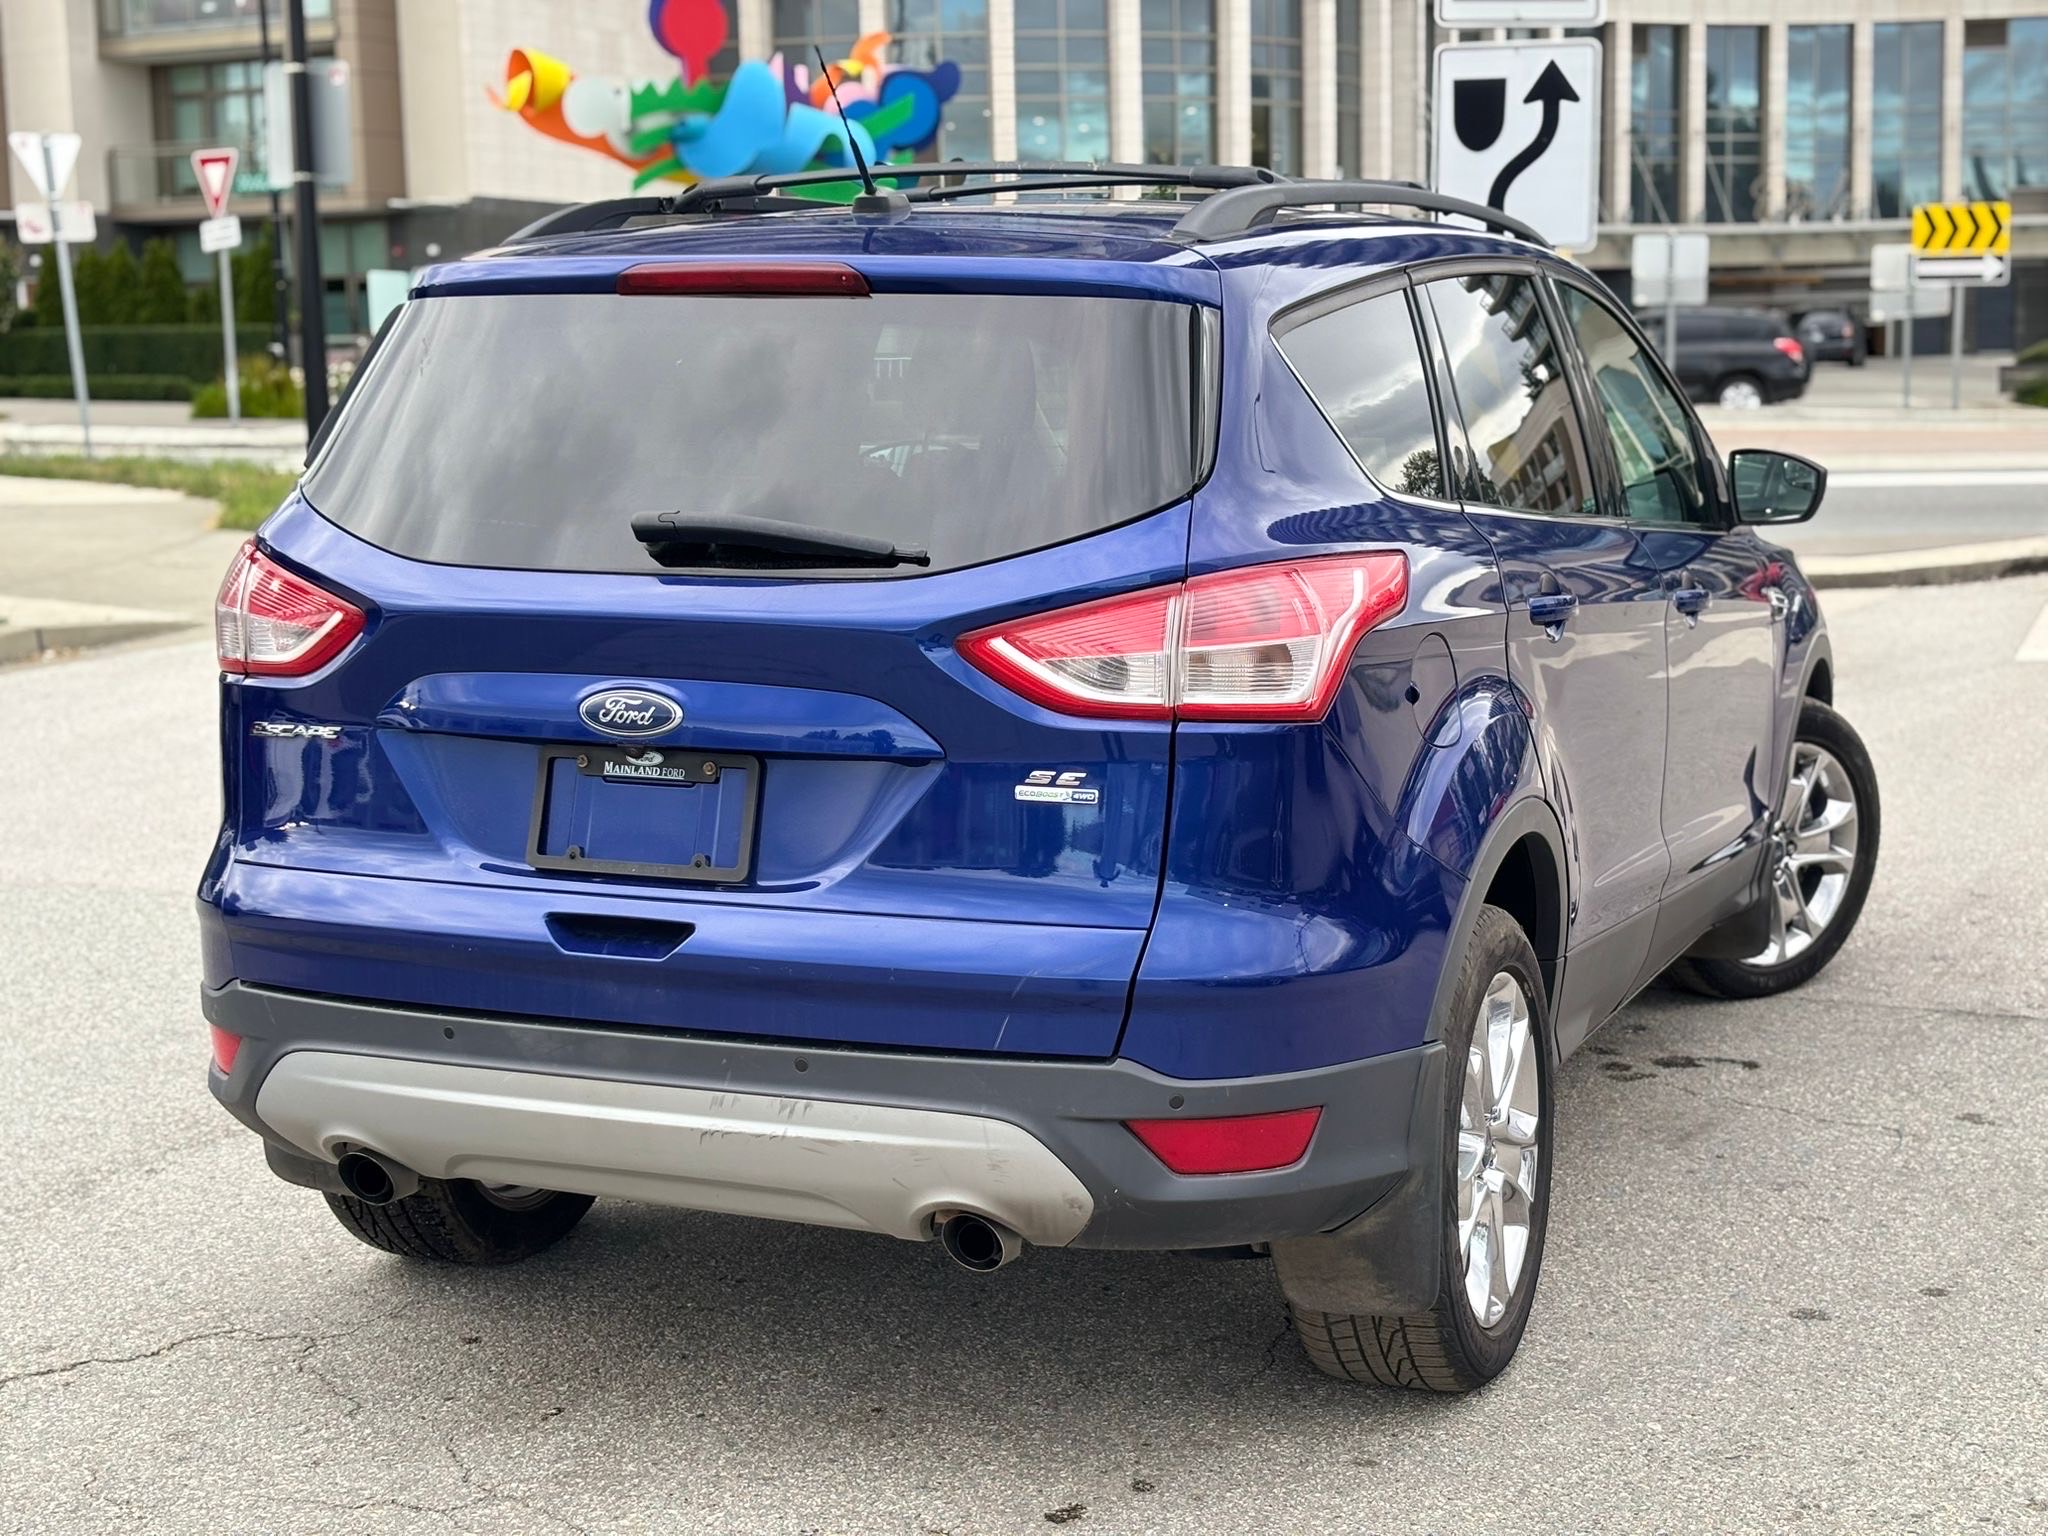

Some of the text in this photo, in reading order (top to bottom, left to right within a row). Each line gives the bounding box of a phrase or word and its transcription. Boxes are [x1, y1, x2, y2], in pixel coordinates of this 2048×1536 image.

[600, 697, 656, 725] Ford
[253, 721, 342, 739] ESCAPE
[604, 761, 686, 779] MAINLAND FORD
[1024, 770, 1087, 785] SE
[1073, 793, 1095, 801] 4WD
